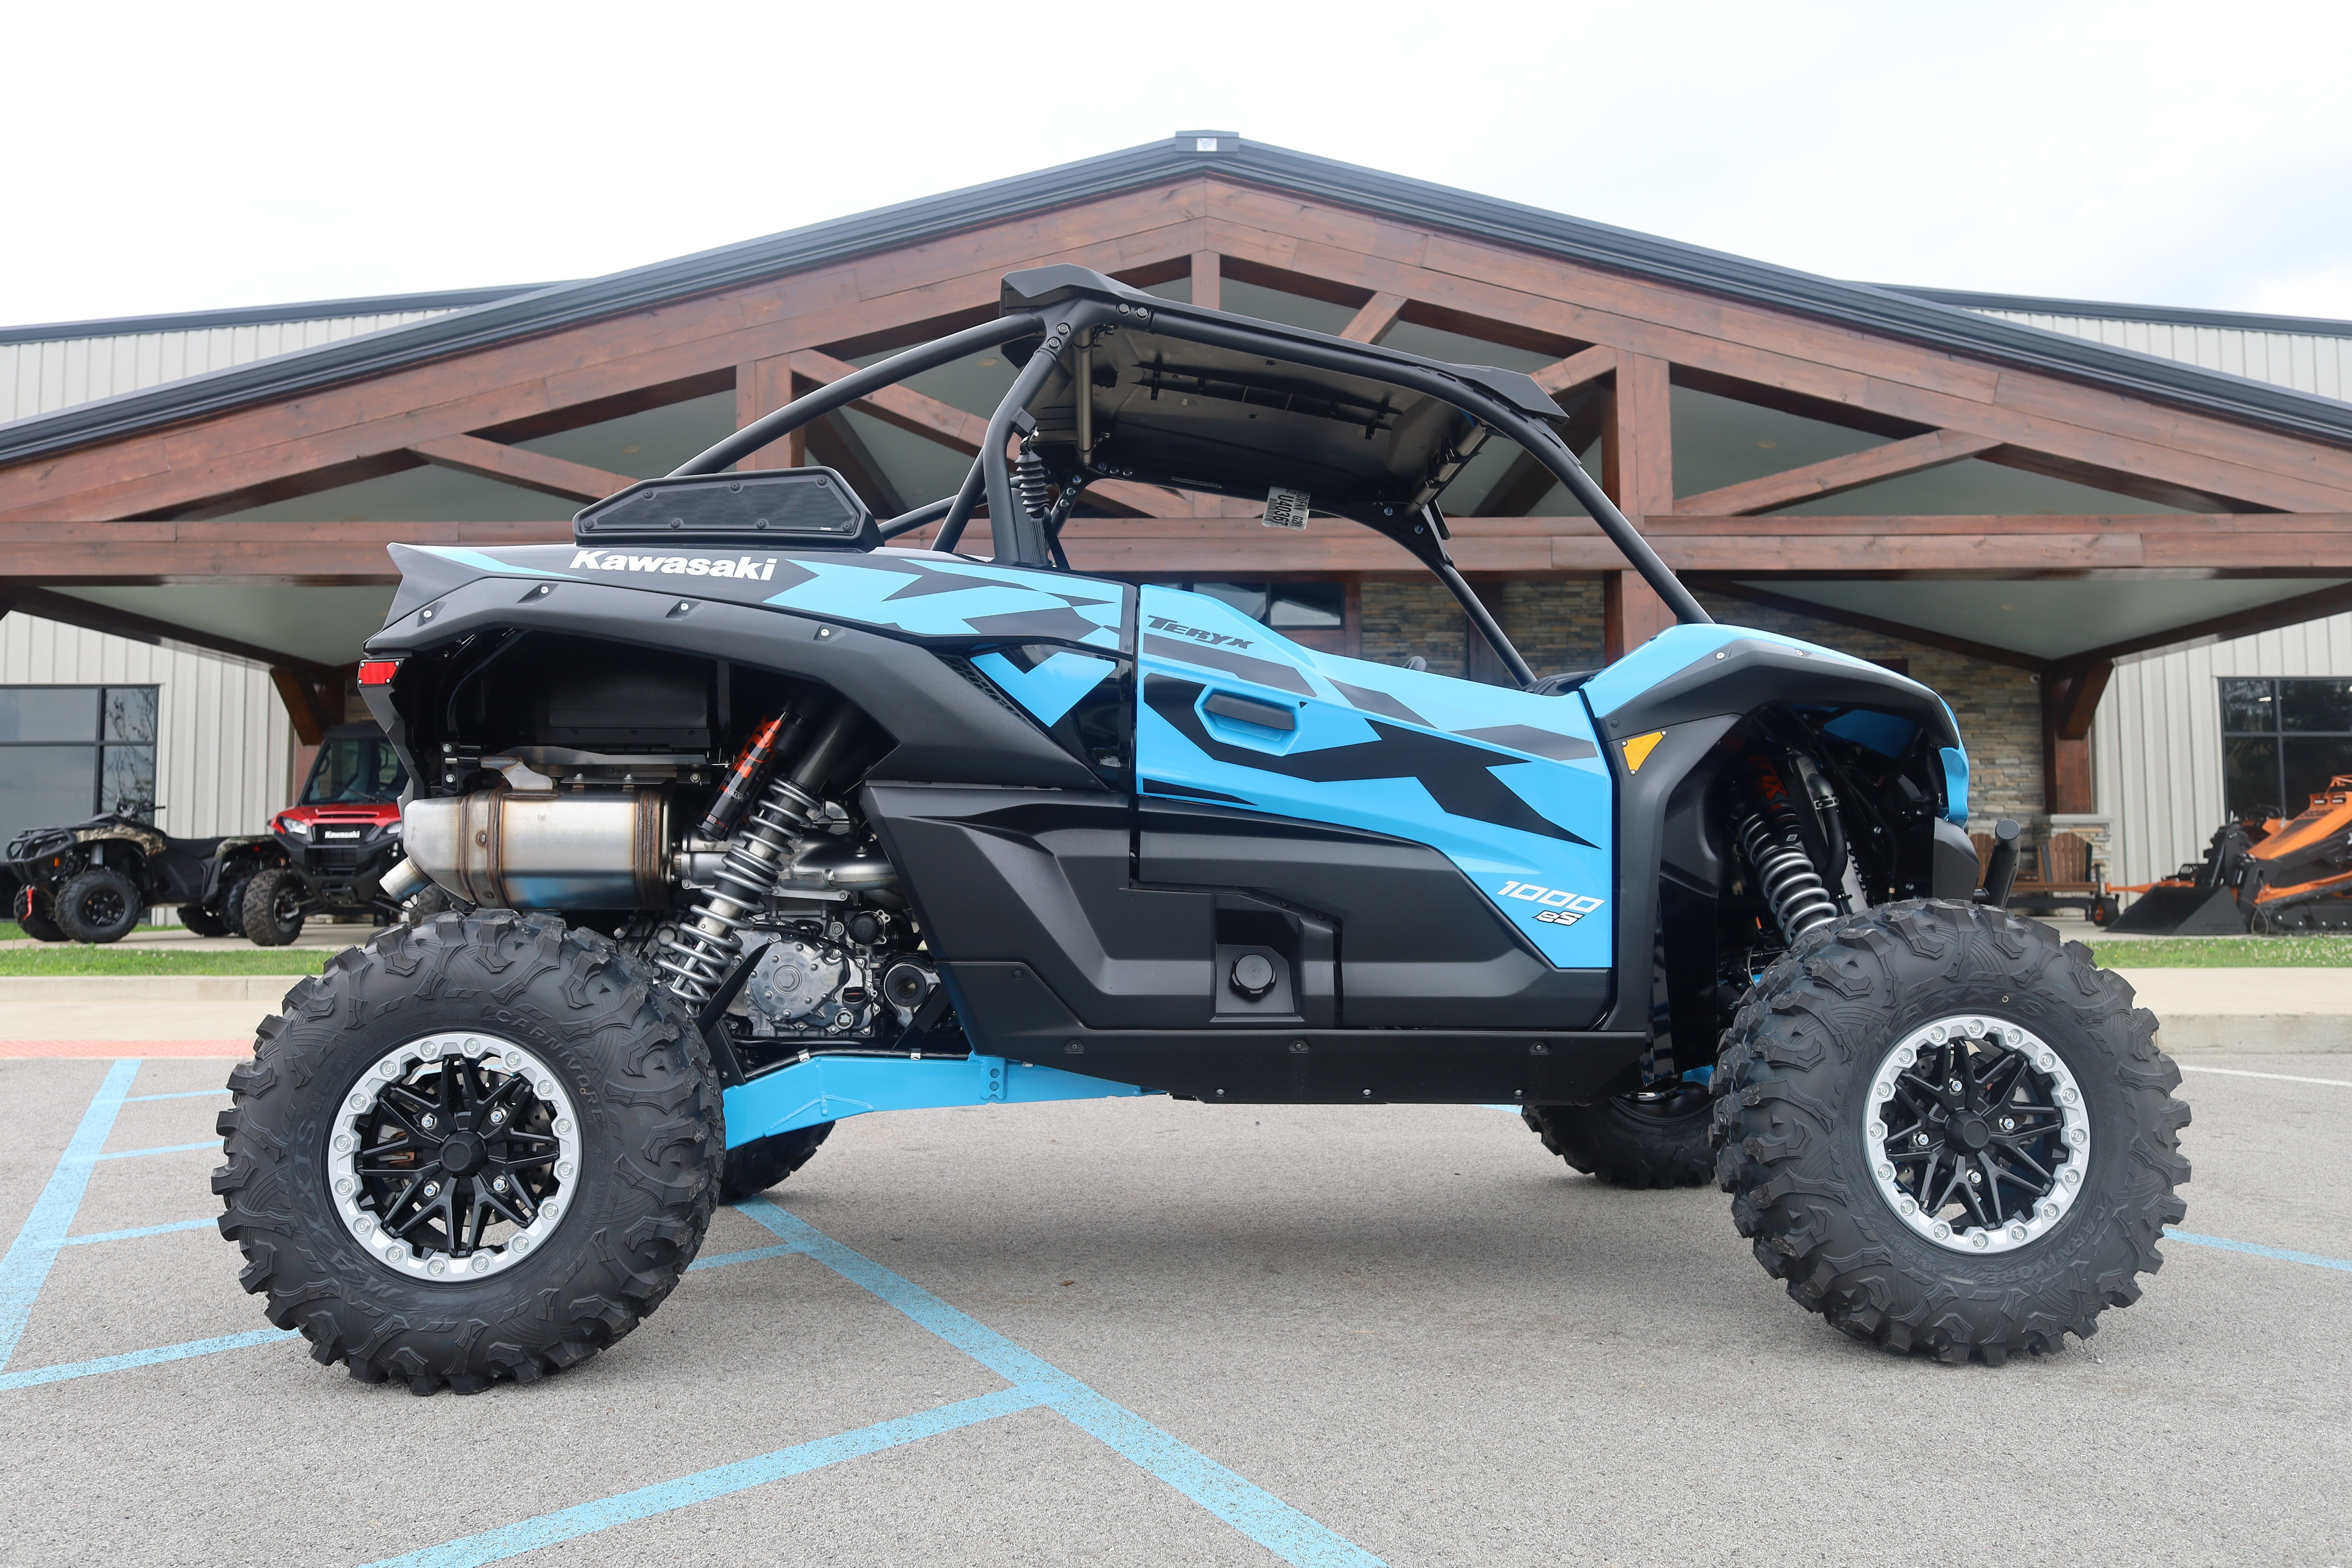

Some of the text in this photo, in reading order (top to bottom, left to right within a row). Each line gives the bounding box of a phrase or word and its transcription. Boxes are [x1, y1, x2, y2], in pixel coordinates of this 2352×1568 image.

[569, 550, 778, 581] Kawasaki
[730, 714, 782, 778] FOX
[325, 830, 360, 839] Kawasaki
[1497, 880, 1606, 913] 1000
[495, 1008, 608, 1124] CARNIVORE
[294, 1115, 403, 1299] MAXXIS
